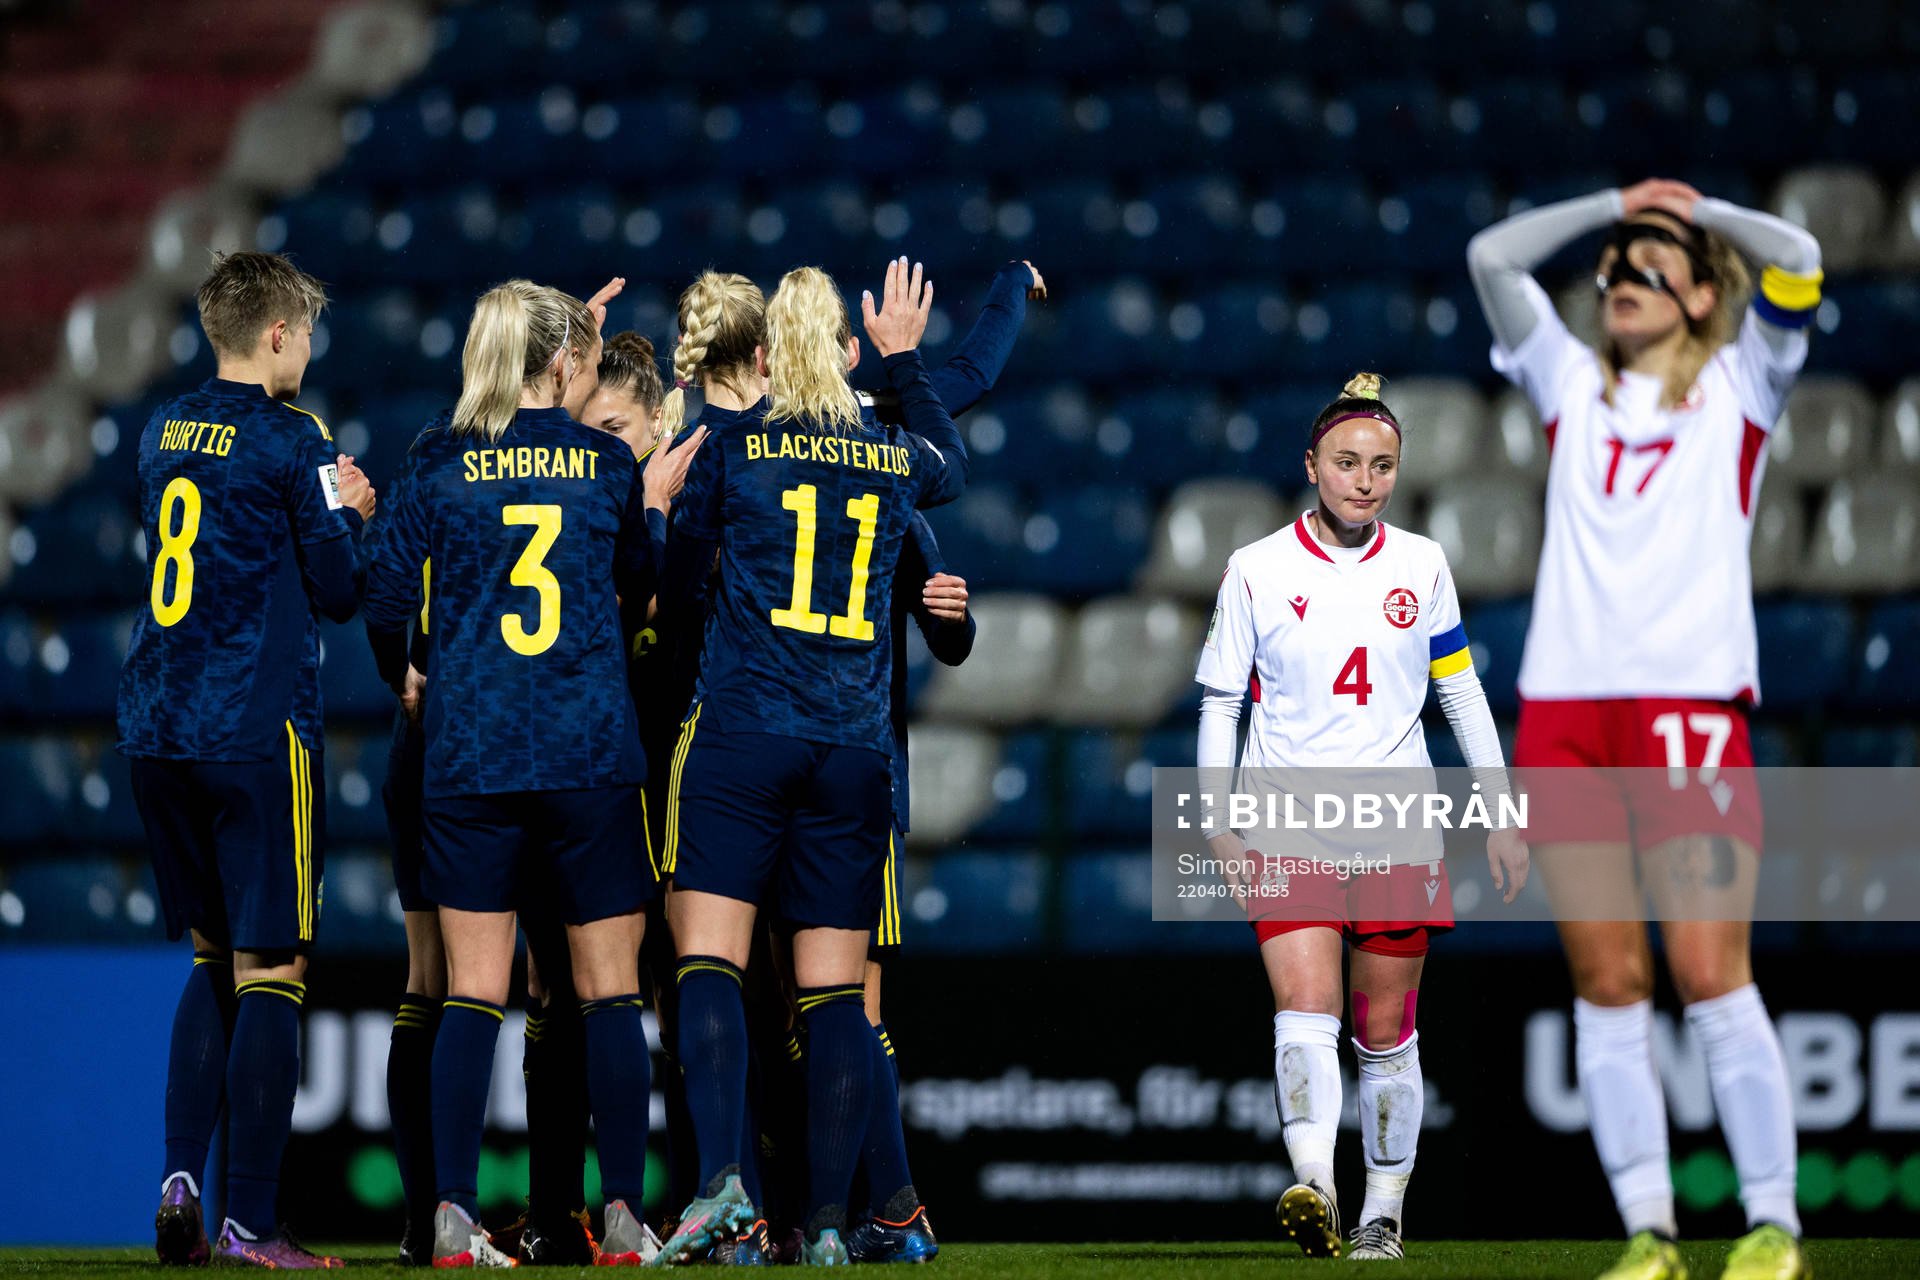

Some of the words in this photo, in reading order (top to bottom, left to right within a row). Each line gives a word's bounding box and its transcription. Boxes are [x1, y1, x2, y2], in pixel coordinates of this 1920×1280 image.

[160, 420, 236, 457] HURTIG
[463, 446, 600, 482] SEMBRANT
[746, 434, 911, 477] BLACKSTENIUS
[1604, 438, 1675, 496] 17
[151, 477, 202, 627] 8
[500, 504, 563, 656] 3
[770, 483, 880, 642] 11
[1384, 602, 1418, 615] Georgia
[1332, 646, 1373, 706] 4
[1651, 711, 1733, 790] 17
